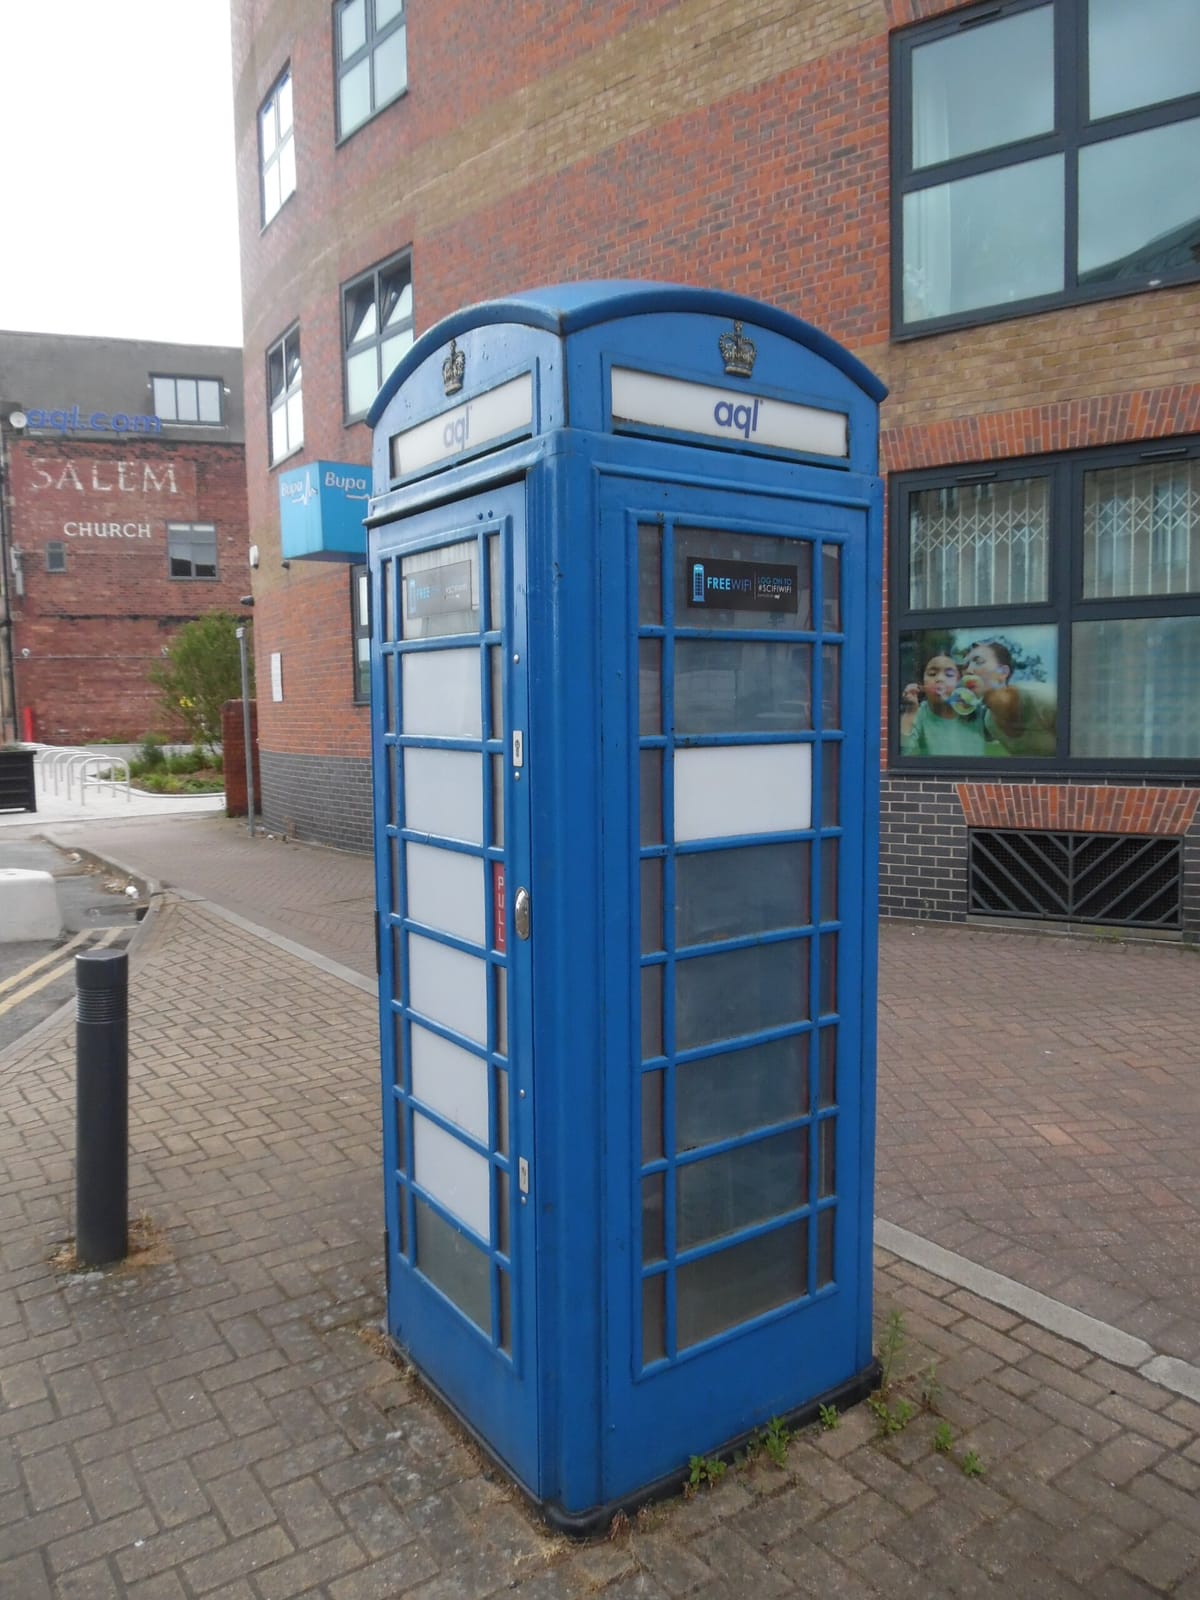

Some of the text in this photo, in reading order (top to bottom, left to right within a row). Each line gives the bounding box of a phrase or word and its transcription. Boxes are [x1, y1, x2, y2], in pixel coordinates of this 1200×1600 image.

[26, 405, 162, 433] aql.com
[443, 405, 470, 451] aql
[714, 399, 759, 438] aql
[31, 456, 178, 493] SALEM
[324, 471, 366, 491] Bupa
[63, 521, 151, 538] CHURCH
